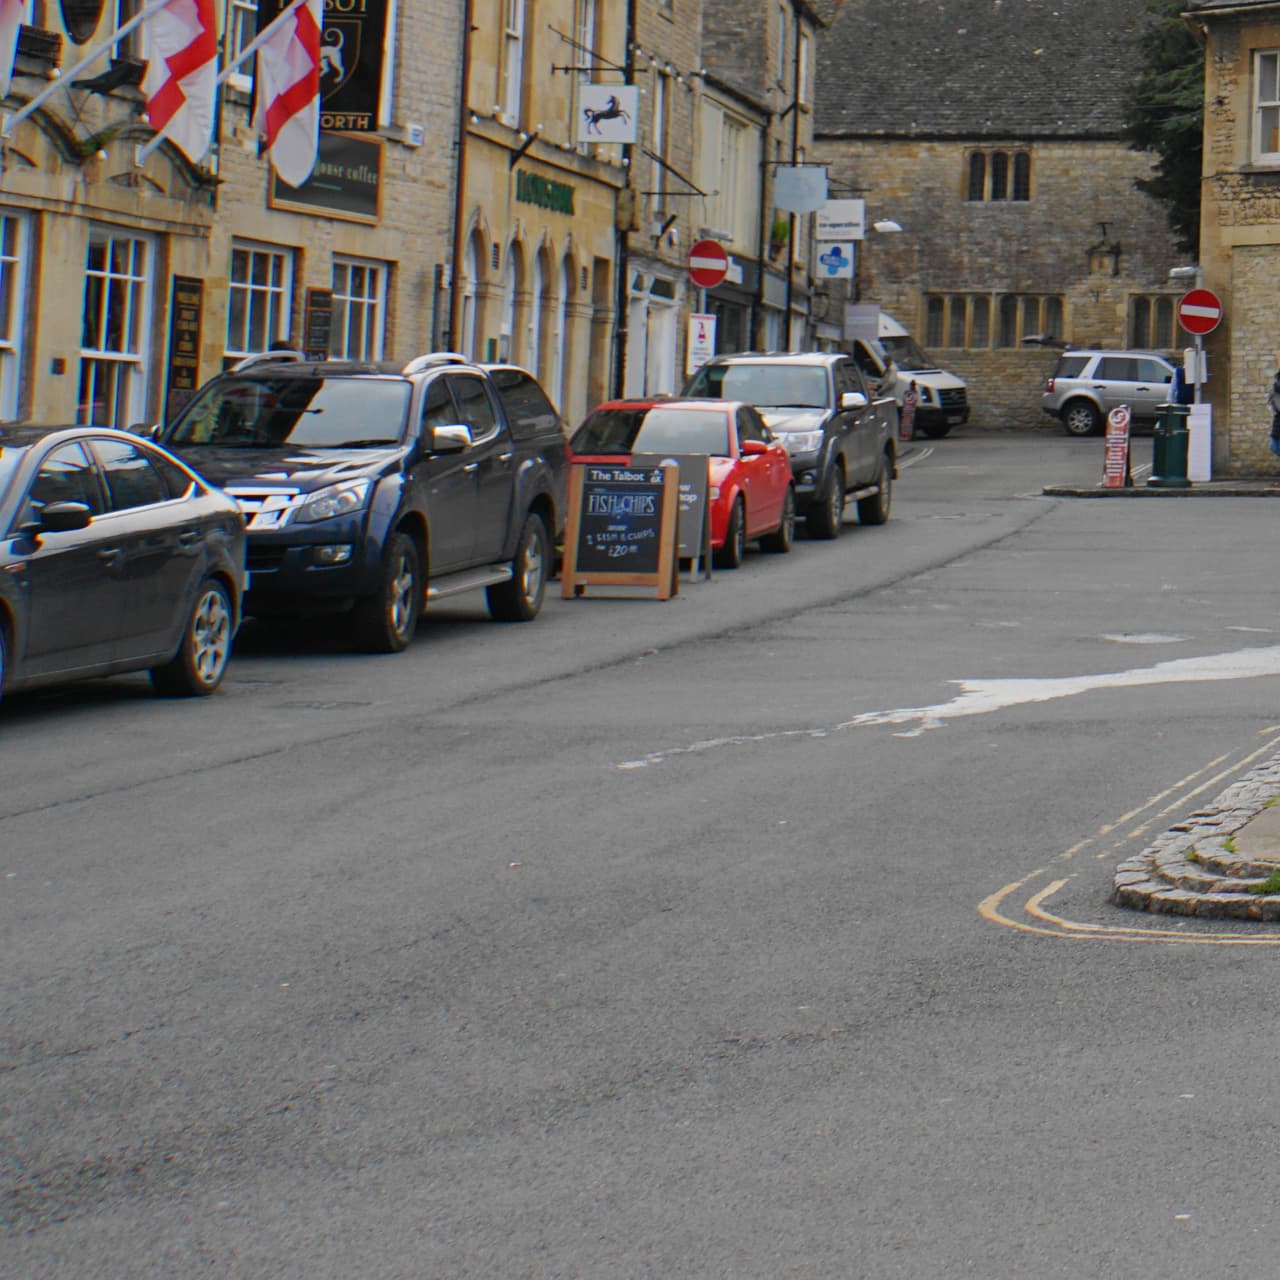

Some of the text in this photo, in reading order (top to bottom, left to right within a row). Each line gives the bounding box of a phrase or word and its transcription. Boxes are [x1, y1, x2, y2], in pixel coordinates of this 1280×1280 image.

[591, 470, 645, 481] The Talbot
[588, 495, 617, 513] FISH
[621, 495, 656, 513] CHIPS
